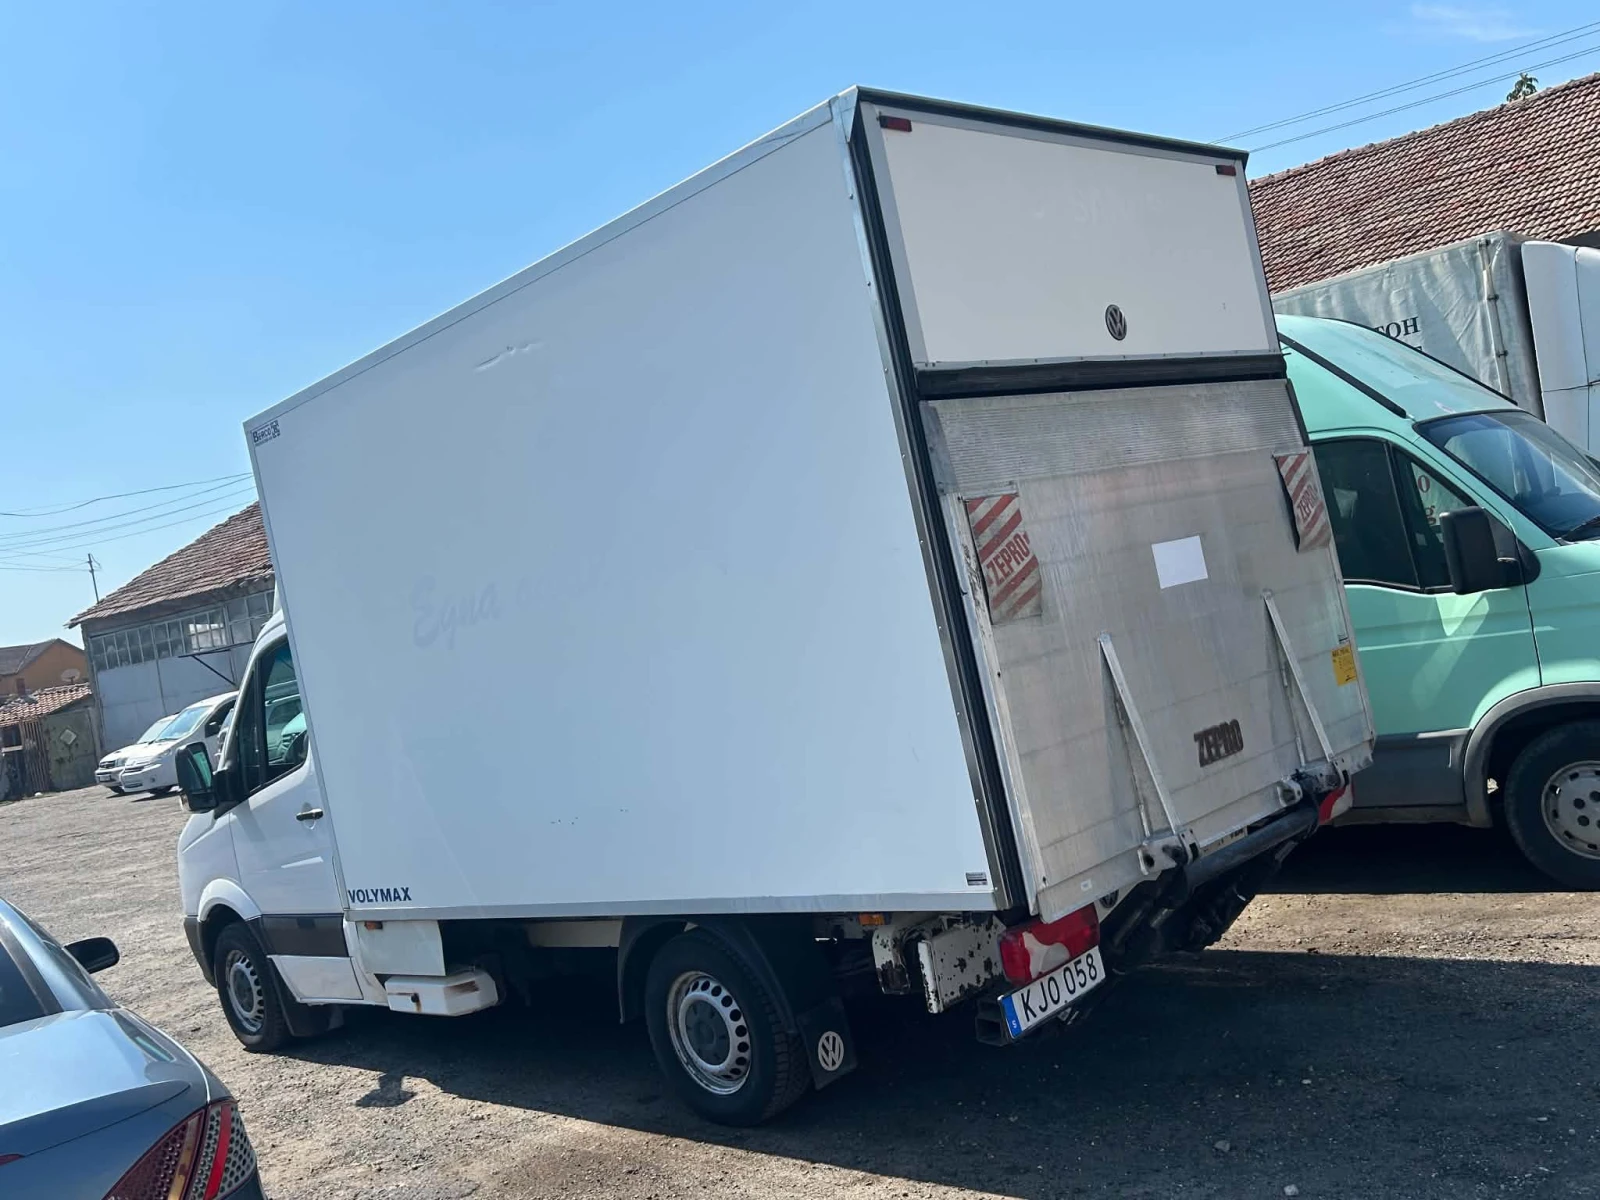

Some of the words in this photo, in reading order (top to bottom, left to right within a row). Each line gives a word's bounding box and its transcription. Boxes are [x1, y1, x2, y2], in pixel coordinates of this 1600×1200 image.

[986, 533, 1031, 586] ZEPRO
[1193, 718, 1244, 768] ZEPRO
[347, 886, 412, 903] VOLYMAX
[1020, 976, 1060, 1022] KJO
[1063, 953, 1098, 995] 058
